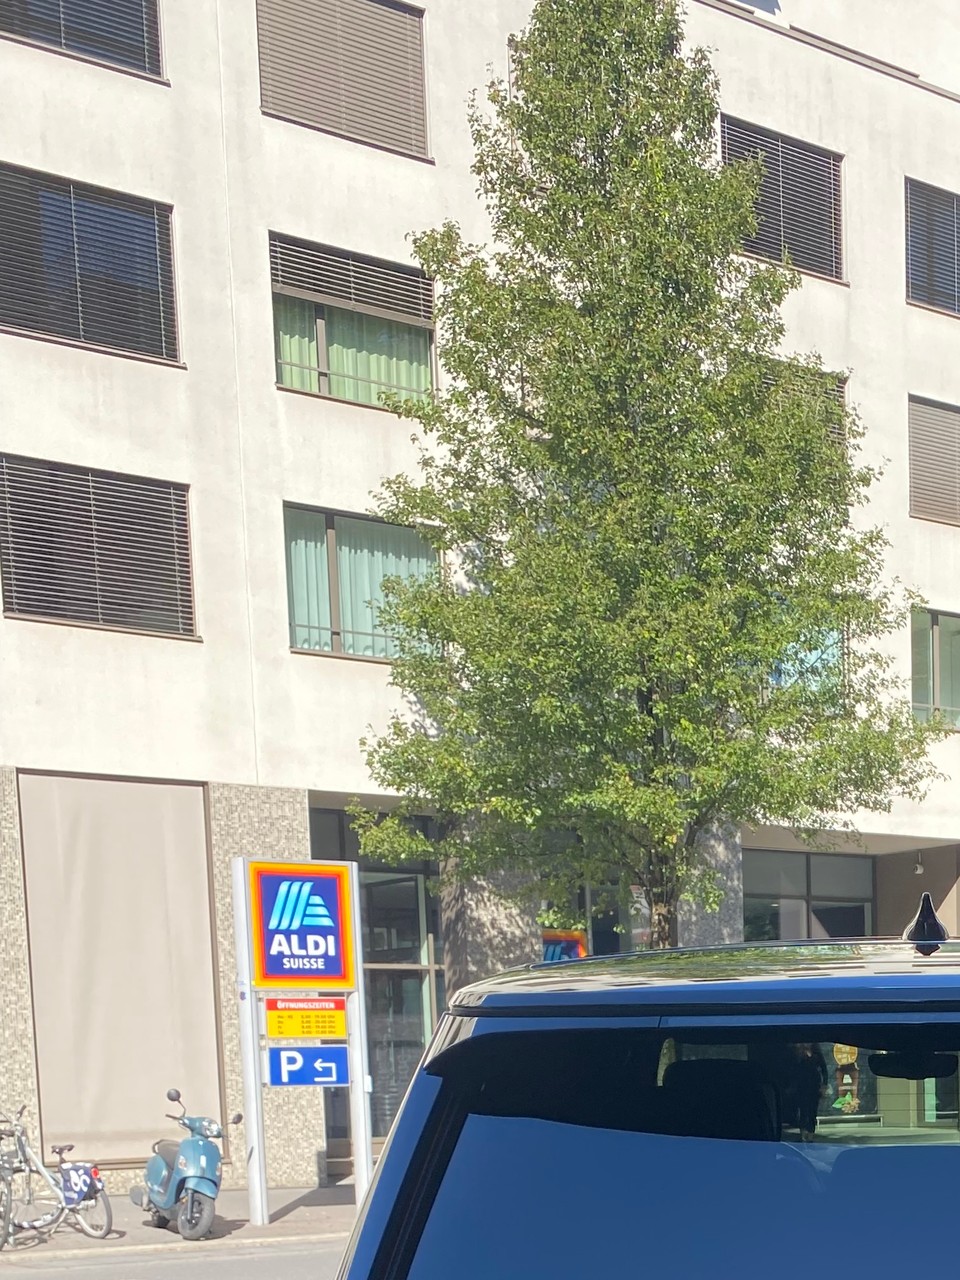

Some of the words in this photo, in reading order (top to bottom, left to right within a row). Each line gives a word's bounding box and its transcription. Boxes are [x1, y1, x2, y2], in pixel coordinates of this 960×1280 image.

[269, 934, 336, 956] ALDI
[282, 957, 326, 970] SUISSE
[279, 1050, 304, 1083] P
